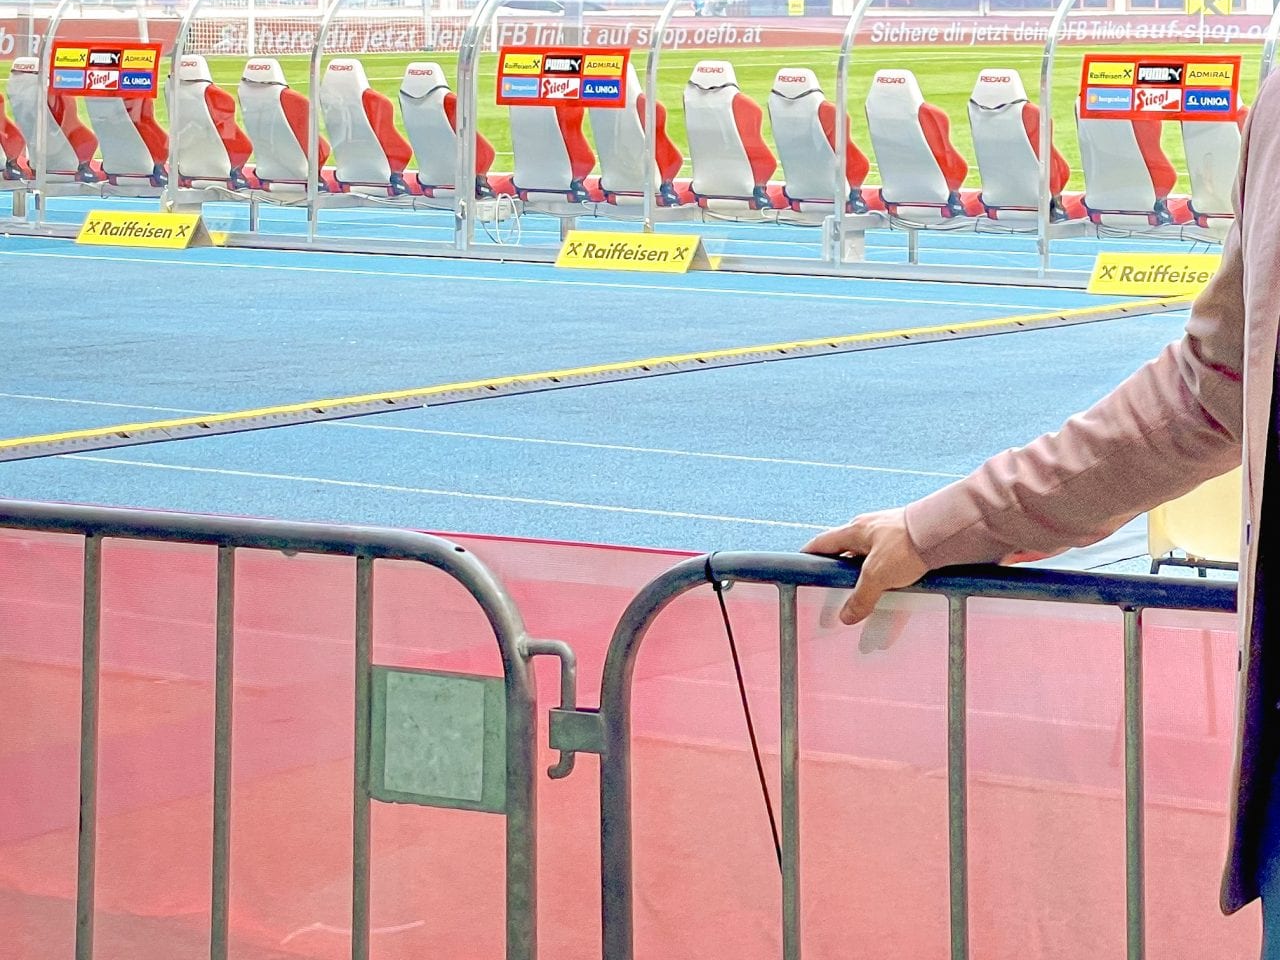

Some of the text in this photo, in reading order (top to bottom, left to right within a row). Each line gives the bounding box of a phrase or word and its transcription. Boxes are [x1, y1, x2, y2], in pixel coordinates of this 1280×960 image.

[214, 25, 316, 50] Sihere
[533, 23, 591, 46] Trikt
[597, 23, 632, 46] auf
[637, 23, 763, 50] sop.oefb.at
[871, 21, 939, 43] Sichere
[943, 21, 971, 42] dir
[969, 22, 1009, 46] jetzt
[1012, 21, 1050, 42] dein
[586, 61, 621, 69] ADMIRAL
[696, 66, 724, 74] RECARO
[1189, 70, 1230, 79] ADMIRAL
[86, 71, 110, 89] Stiegl
[778, 75, 806, 83] RECARO
[876, 76, 906, 84] RECARO
[980, 75, 1011, 83] RECARO
[1089, 72, 1122, 80] Raiffeisen
[542, 78, 570, 98] Stiegl
[595, 86, 618, 94] UNIQA
[1135, 89, 1168, 111] Stiegl
[1200, 97, 1228, 106] UNIQA
[100, 221, 173, 239] Raiffeisen
[583, 242, 669, 262] Raiffeisen
[1120, 265, 1214, 283] Raiffeise
